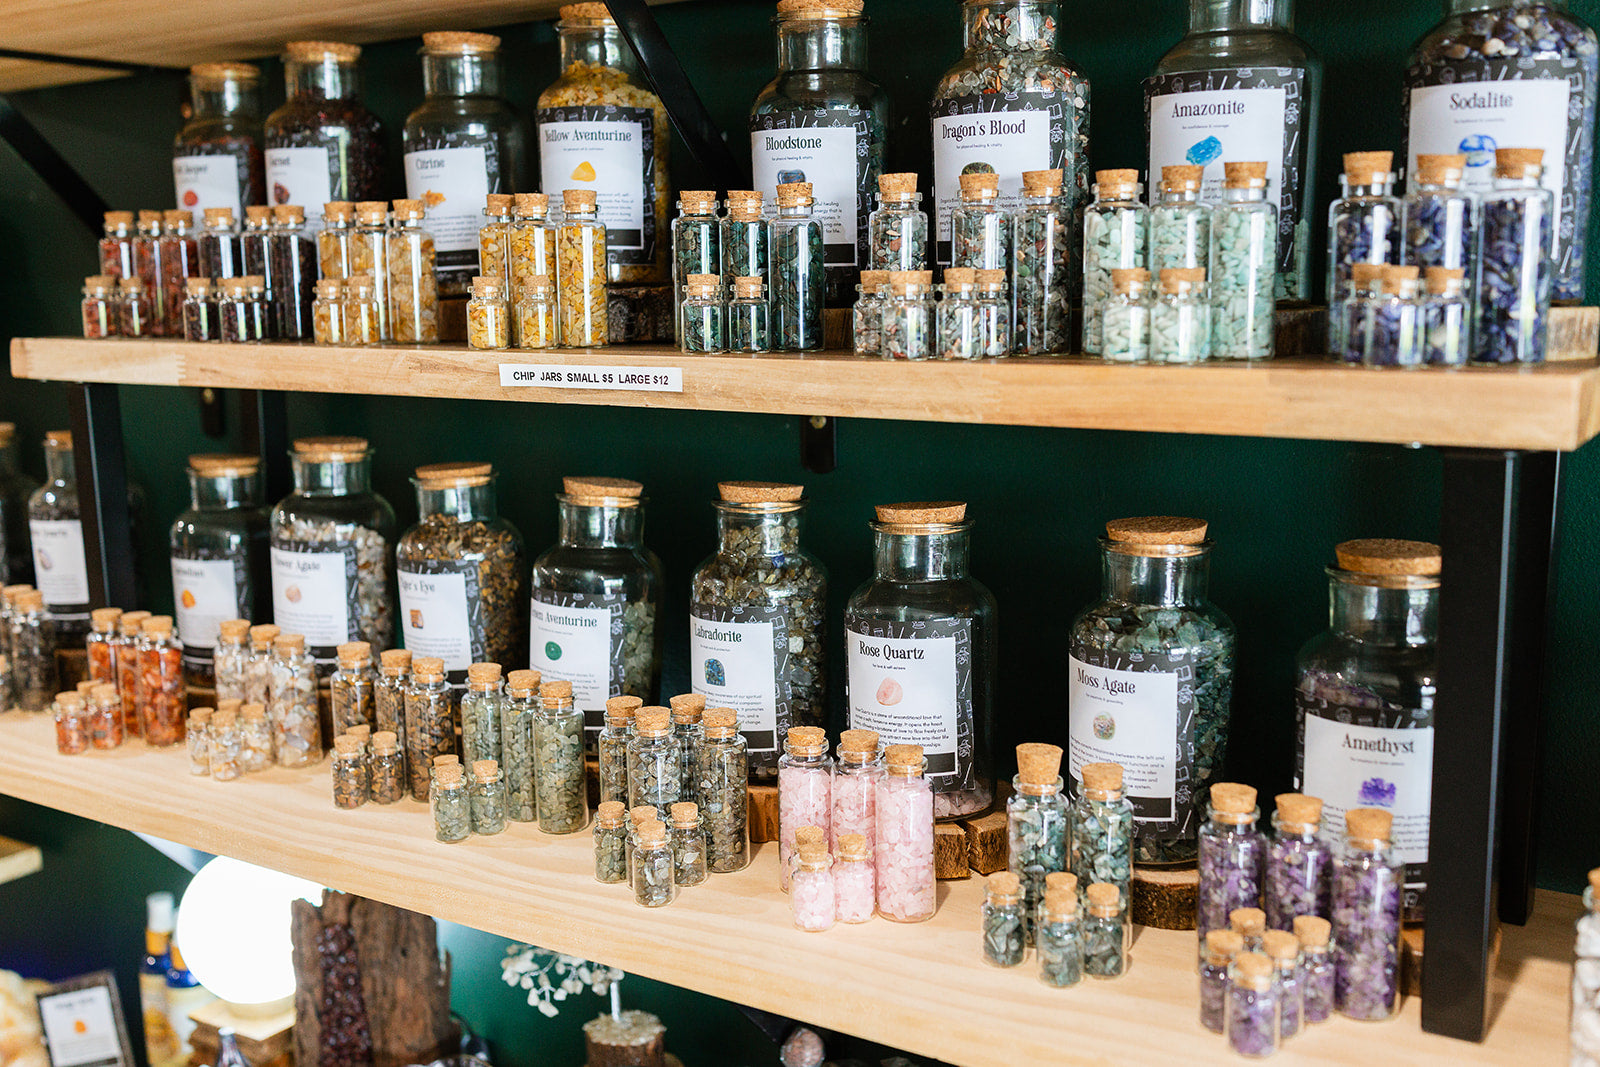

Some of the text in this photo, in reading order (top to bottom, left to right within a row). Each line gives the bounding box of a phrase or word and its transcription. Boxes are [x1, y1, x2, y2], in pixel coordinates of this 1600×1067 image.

[1171, 100, 1245, 118] Amazonite
[1449, 91, 1513, 110] Sodalite
[544, 129, 632, 142] Yellow Aventurine
[942, 119, 1026, 143] Dragon's Blood
[765, 135, 822, 151] Bloodstone
[415, 159, 446, 171] Citrine
[513, 371, 669, 386] CHIP JARS SMALL $5 LARGE $12
[546, 612, 598, 628] Aventurine
[694, 622, 742, 643] Labradorite
[859, 640, 925, 661] Rose Quartz
[1077, 667, 1099, 689] Moss
[1102, 676, 1136, 697] Agate
[1342, 733, 1414, 757] Amethyst
